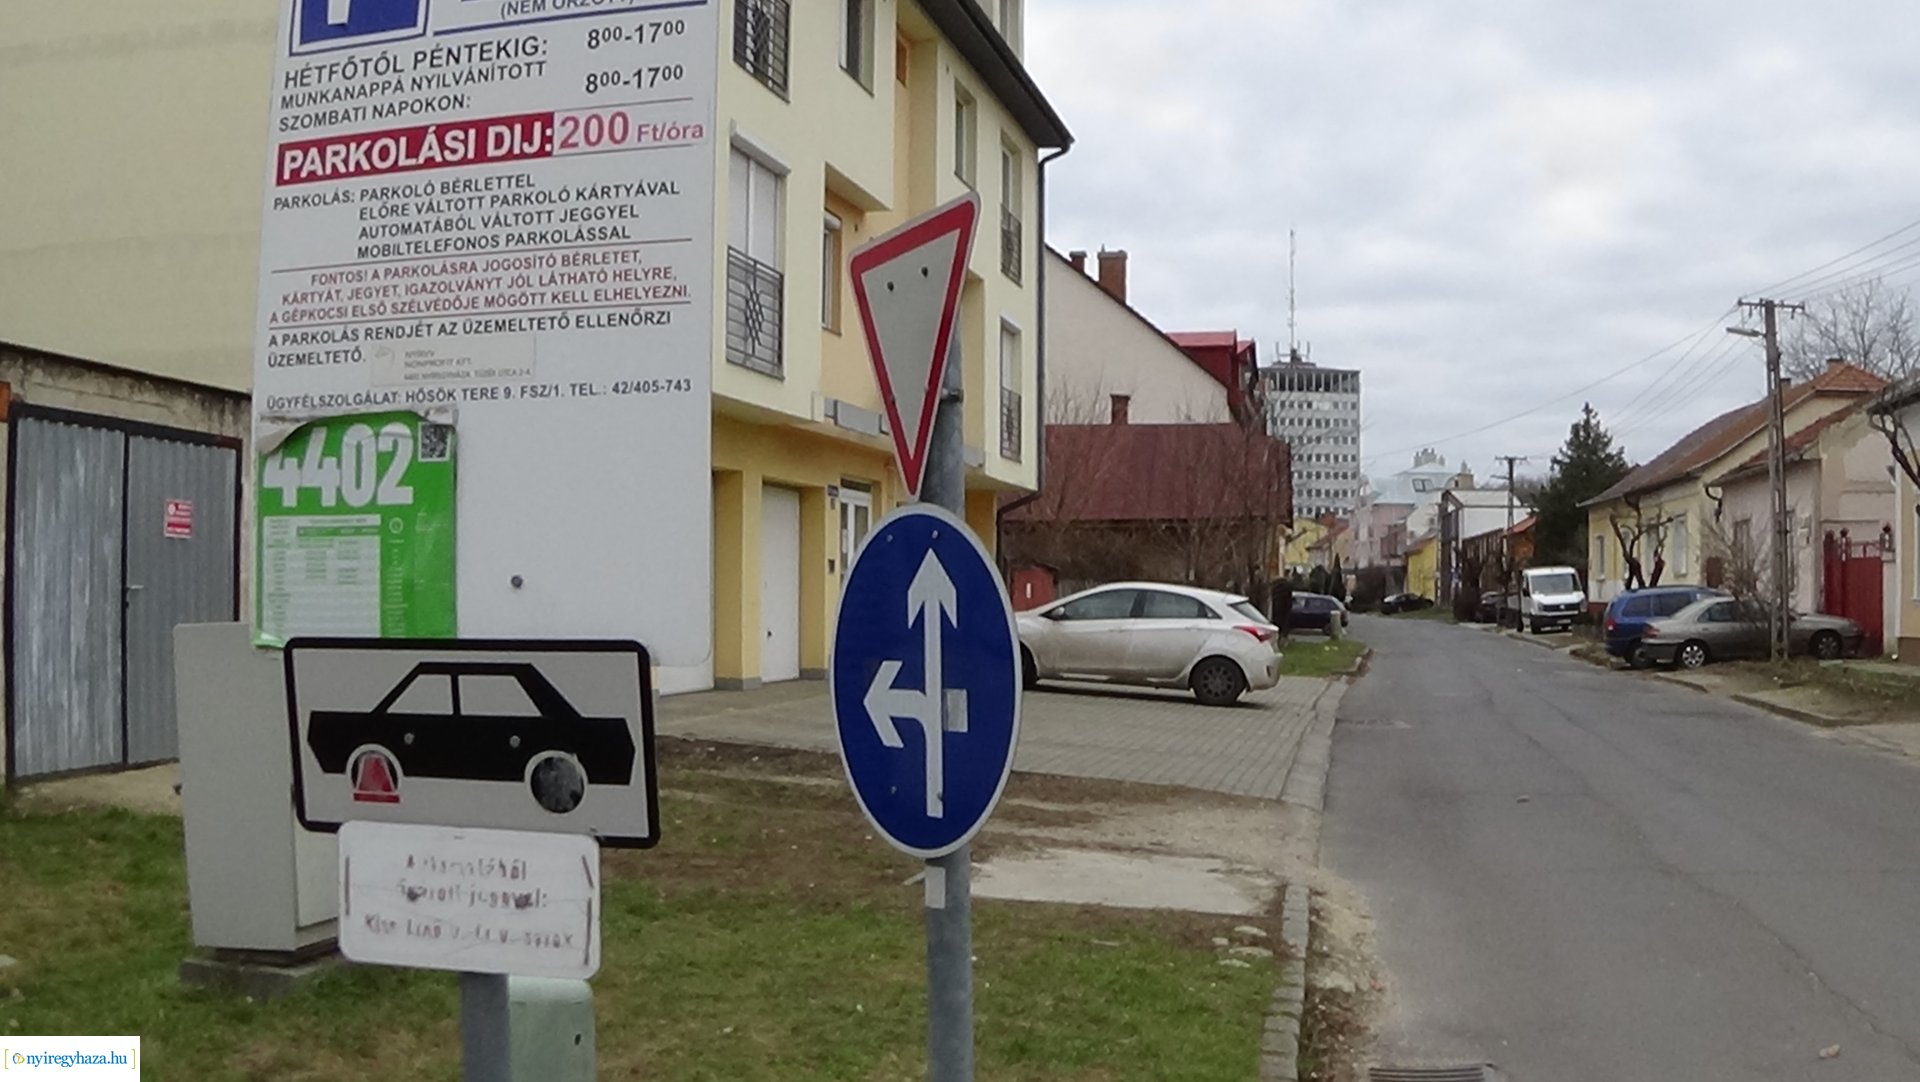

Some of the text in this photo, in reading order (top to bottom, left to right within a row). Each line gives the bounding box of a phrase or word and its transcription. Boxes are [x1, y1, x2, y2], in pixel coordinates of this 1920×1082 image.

[284, 35, 547, 89] HÉTFŐTŐL PÉNTEKIG:
[281, 61, 546, 109] MUNKANAPPÁ NYILVÁNÍTOTT
[279, 94, 471, 132] SZOMBATI NAPOKON:
[283, 111, 704, 180] PARKOLÁSI DIJ: 200 Ft/óra
[273, 174, 535, 210] PARKOLÁS: PARKOLÓ BÉRLETTEL
[359, 179, 680, 220] ELŐRE VÁLTOTT PARKOLÓ KÁRTYÁVAL
[359, 204, 639, 240] AUTOMATÁBÓL VÁLTOTT JEGGYEL
[357, 225, 631, 259] MOBILTELEFONOS PARKOLÁSSAL
[282, 266, 677, 306] KÁRTYÁT, JEGYET, IGAZOLVÁNYT JÓL LÁTHATÓ HELYRE,
[311, 249, 642, 286] FONTOS! A PARKOLÁSRA JOGOSÍTÓ BÉRLETET,
[269, 285, 691, 324] A GÉPKOCSI ELSŐ SZÉLVÉDŐJE MÖGÖTT KELL ELHELYEZNI.
[268, 308, 671, 348] A PARKOLÁS RENDJÉT AZ ÜZEMELTETŐ ELLENŐRZI
[406, 387, 456, 404] HŐSÖK
[462, 386, 499, 400] TERE
[612, 378, 691, 394] 42/405-743
[263, 422, 414, 507] 4402
